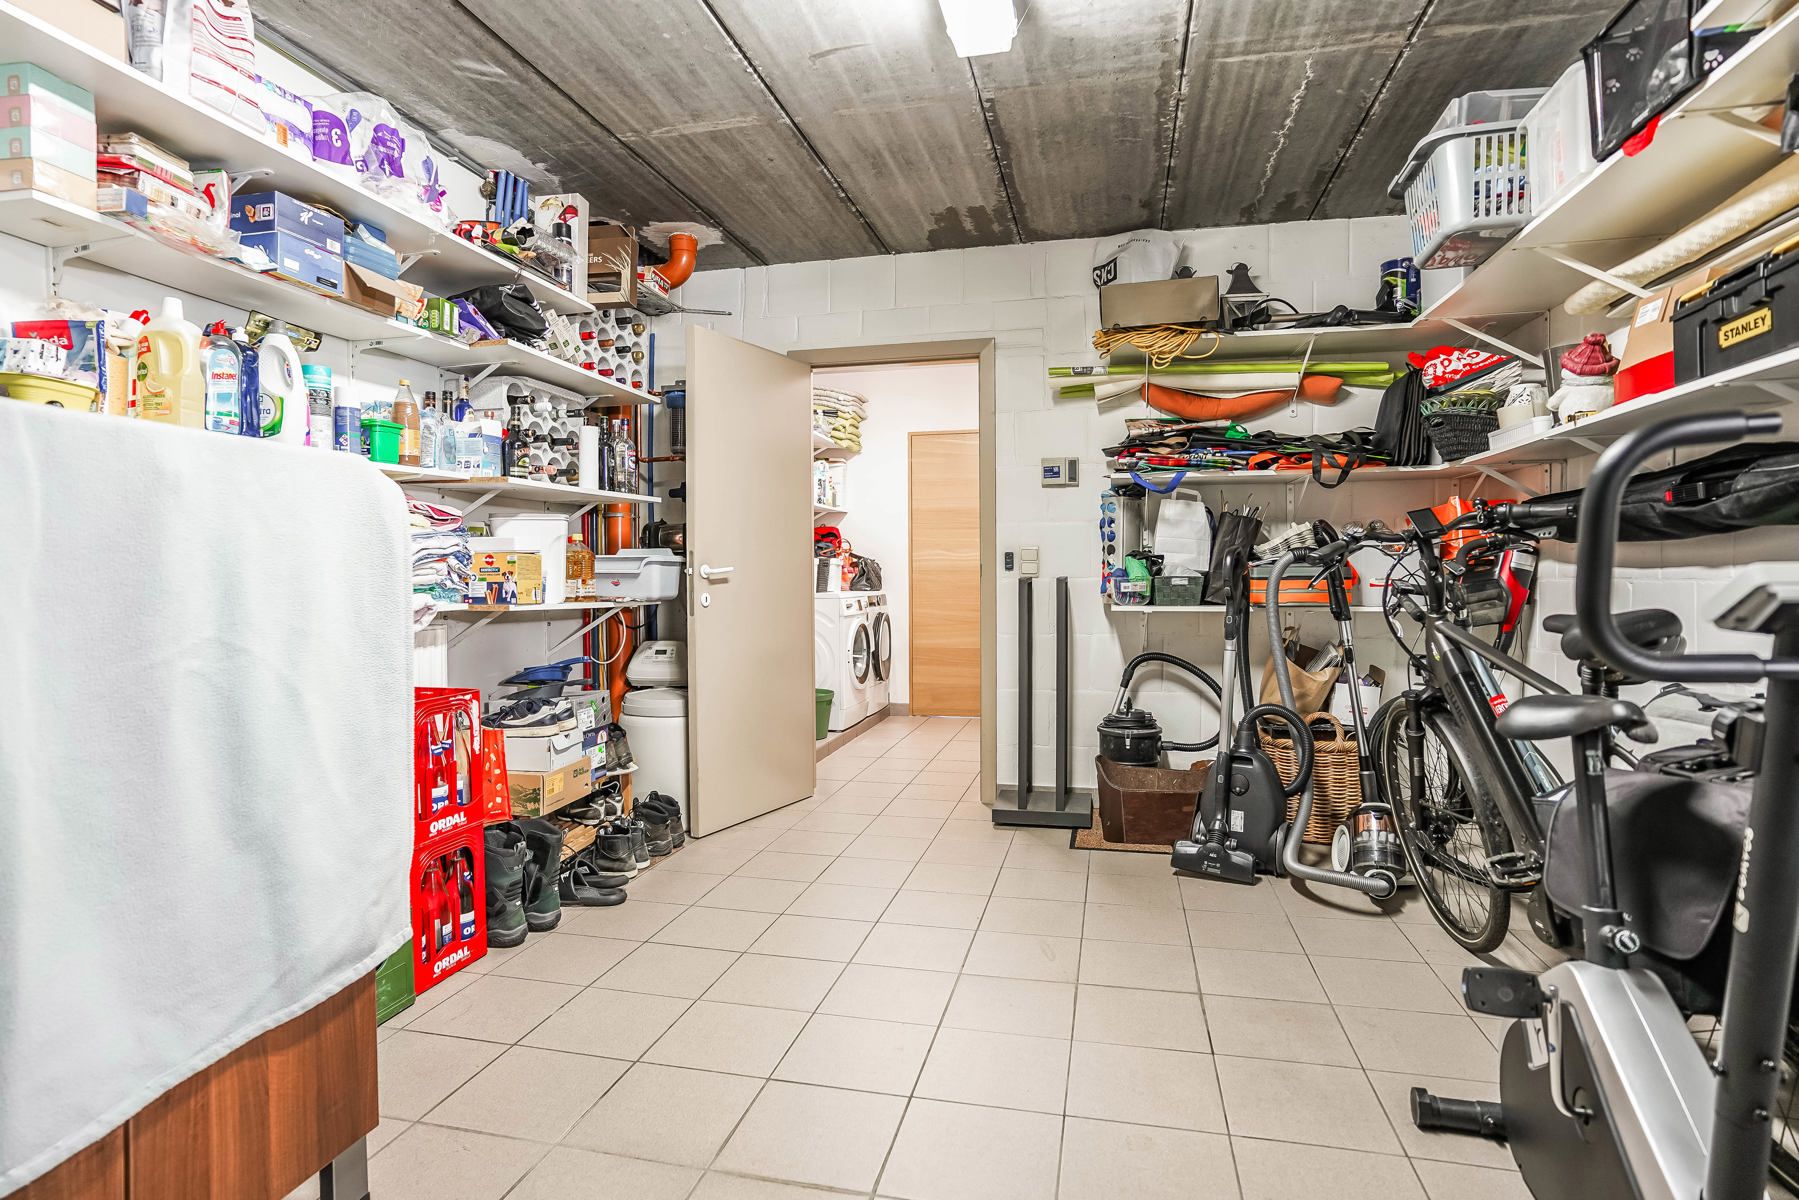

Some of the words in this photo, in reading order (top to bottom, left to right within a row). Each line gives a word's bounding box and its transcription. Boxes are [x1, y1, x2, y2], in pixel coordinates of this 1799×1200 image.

[1724, 314, 1767, 341] STANLEY
[429, 811, 467, 834] ORDAL
[433, 945, 471, 973] ORDAL
